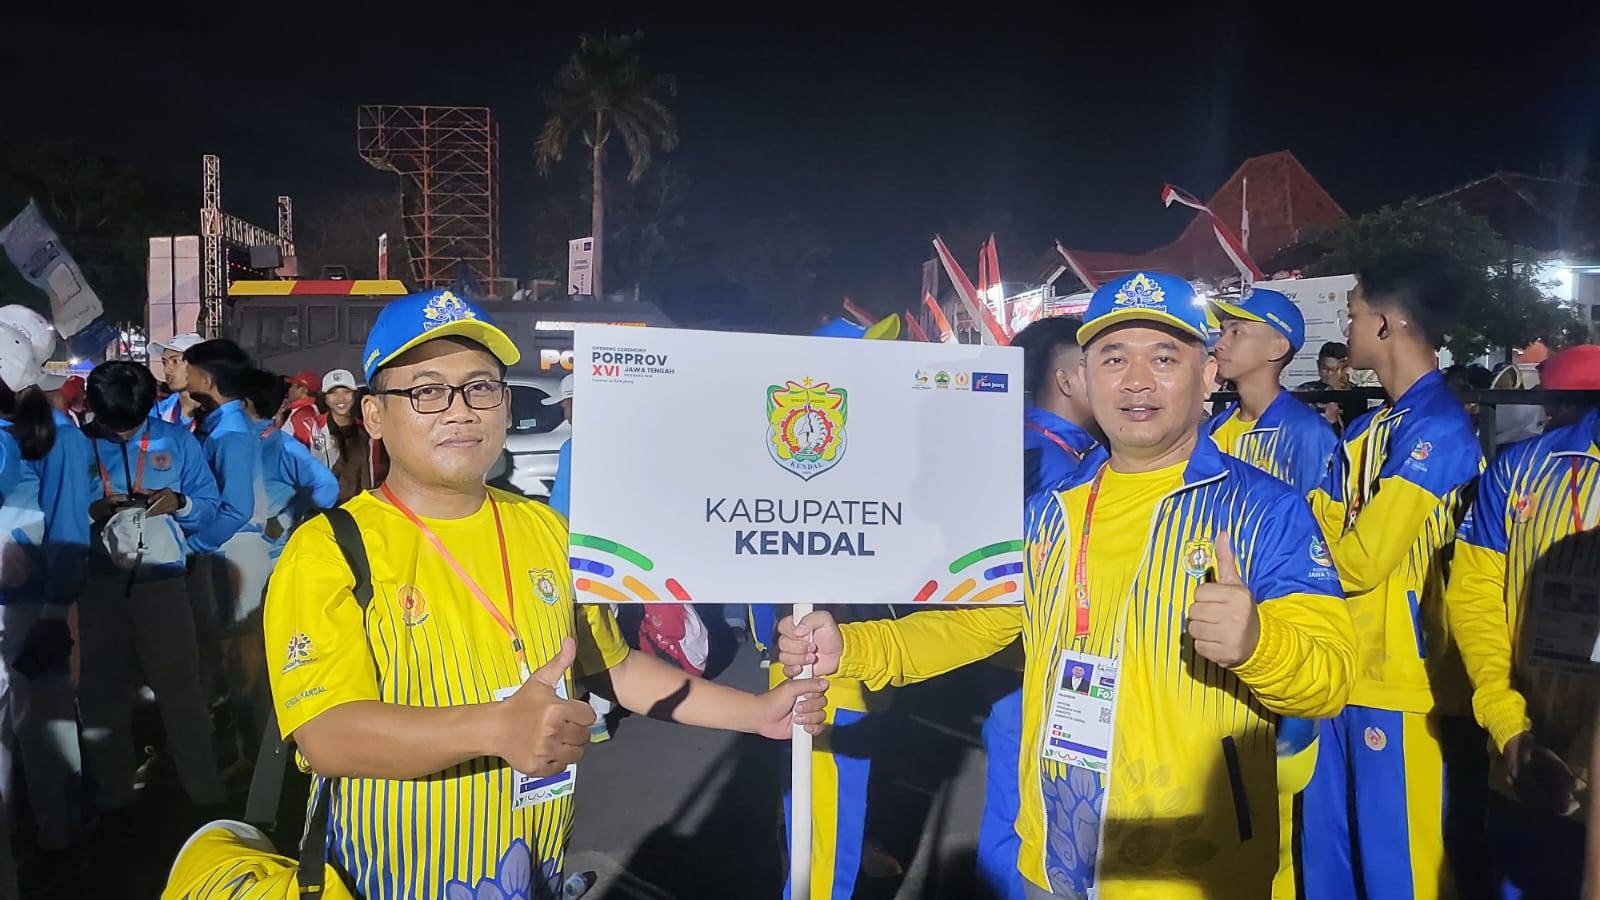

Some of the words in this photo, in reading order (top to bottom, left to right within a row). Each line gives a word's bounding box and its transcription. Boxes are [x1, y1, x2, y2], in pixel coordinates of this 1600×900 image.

[592, 352, 668, 366] PORPROV
[592, 365, 620, 377] XVI
[790, 461, 823, 470] KENDAL
[706, 498, 902, 526] KABUPATEN
[735, 530, 875, 556] KENDAL
